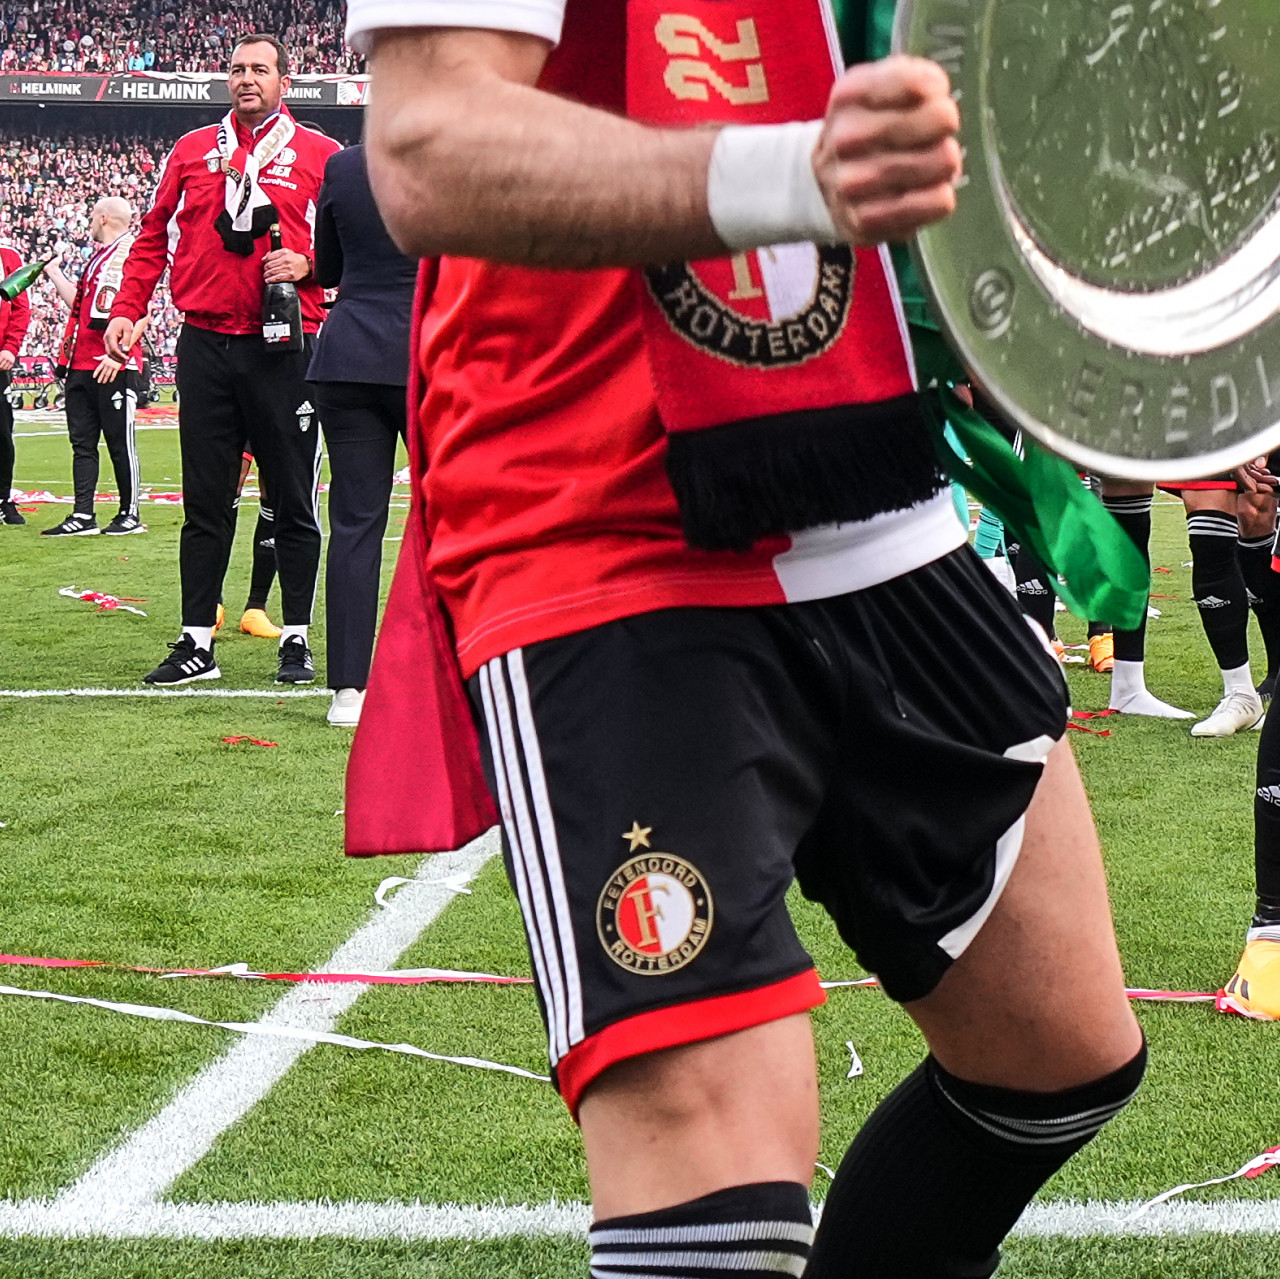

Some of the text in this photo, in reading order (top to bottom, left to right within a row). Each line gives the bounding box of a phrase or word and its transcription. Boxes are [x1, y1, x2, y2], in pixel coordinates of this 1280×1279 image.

[654, 13, 769, 105] 22
[21, 83, 81, 96] HELMINK
[123, 82, 211, 101] HELMINK
[282, 87, 322, 99] MINK
[266, 164, 293, 178] JEX
[663, 262, 845, 358] ROTTERDAM
[603, 858, 698, 910] FEYENOORD
[610, 917, 708, 970] ROTTERDAM
